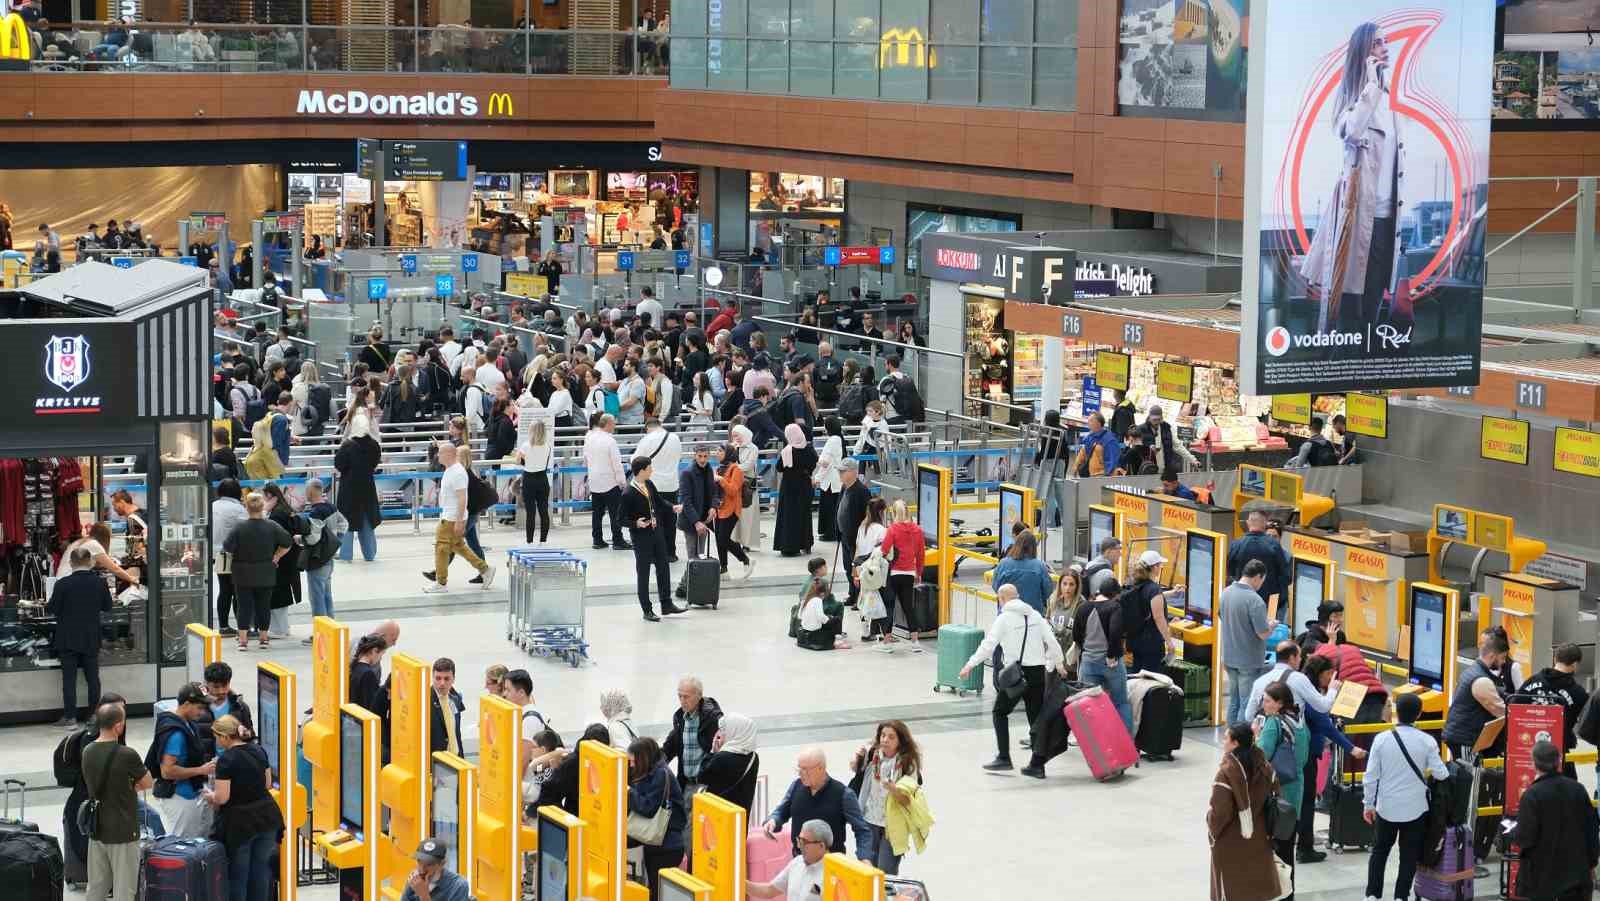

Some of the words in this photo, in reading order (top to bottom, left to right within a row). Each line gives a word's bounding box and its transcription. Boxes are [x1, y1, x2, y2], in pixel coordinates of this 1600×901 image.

[296, 90, 478, 116] McDonald's
[403, 259, 415, 269] 29
[463, 258, 476, 268] 30
[621, 256, 632, 266] 31
[678, 254, 688, 264] 32
[883, 251, 890, 262] 2
[1011, 255, 1024, 294] F
[1043, 257, 1063, 297] F
[1111, 263, 1153, 297] Delight
[371, 283, 385, 294] 27
[438, 280, 450, 291] 28
[1063, 315, 1080, 335] F16
[1124, 324, 1141, 343] F15
[1293, 330, 1362, 348] vodafone
[1375, 323, 1412, 349] Red
[35, 396, 101, 408] KRTLYVS
[1519, 383, 1542, 407] F11
[1116, 495, 1146, 512] PEGASUS
[1163, 507, 1194, 523] PEGASUS
[1293, 538, 1328, 556] PEGASUS
[1348, 551, 1384, 569] PEGASUS
